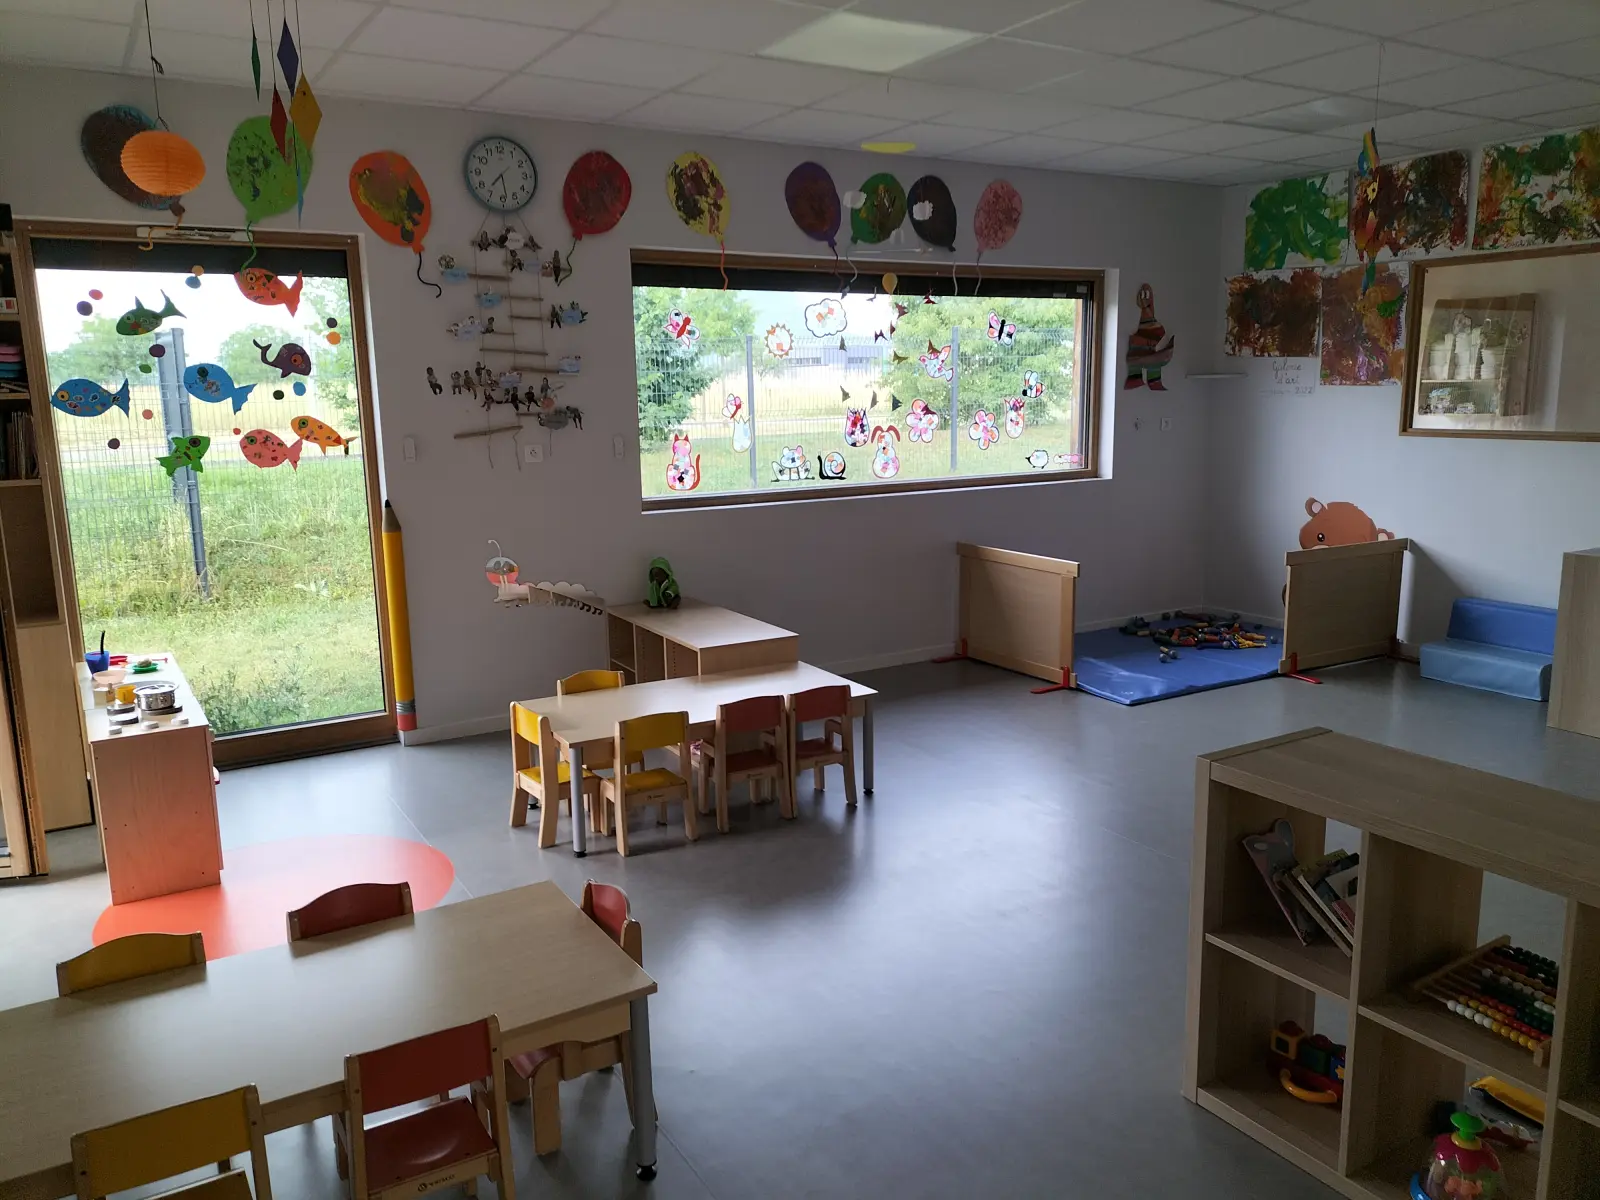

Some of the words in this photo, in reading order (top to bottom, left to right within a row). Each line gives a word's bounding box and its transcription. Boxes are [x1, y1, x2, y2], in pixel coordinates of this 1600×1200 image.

[485, 148, 493, 156] 11
[495, 146, 504, 154] 12
[477, 156, 488, 165] 10
[518, 159, 524, 168] 2
[474, 167, 481, 176] 9
[522, 171, 528, 180] 3
[478, 180, 485, 189] 8
[487, 189, 493, 198] 7
[512, 192, 518, 200] 5
[499, 194, 507, 203] 6
